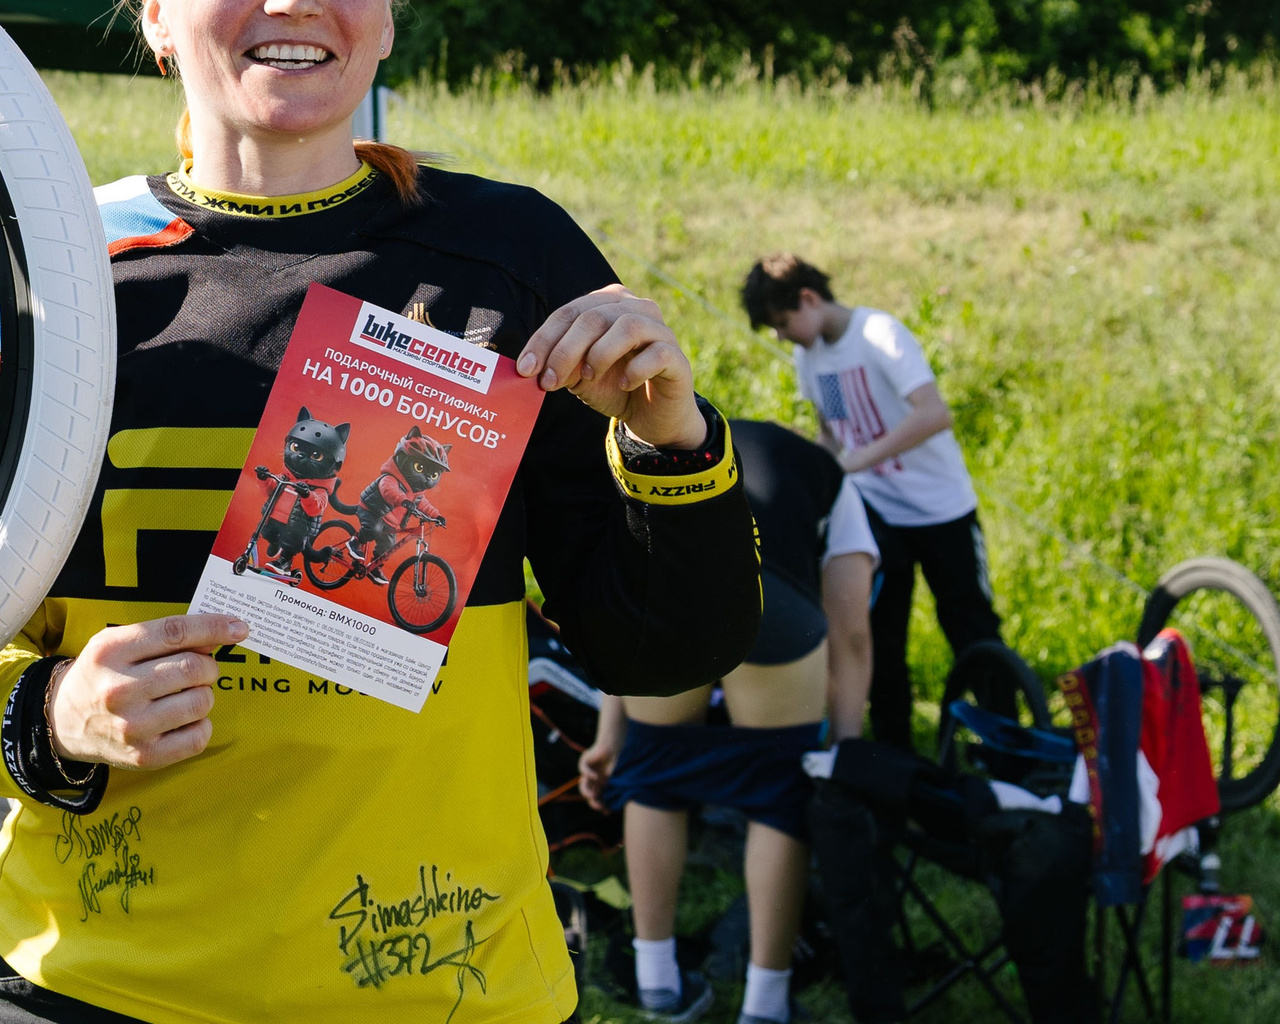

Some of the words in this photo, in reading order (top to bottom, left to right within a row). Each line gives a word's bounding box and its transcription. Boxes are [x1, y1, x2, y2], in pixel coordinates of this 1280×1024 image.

[202, 195, 274, 216] ЖМИ
[280, 203, 303, 215] И
[302, 358, 332, 385] НА
[339, 373, 394, 407] 1000
[324, 347, 413, 390] ПОДАРОЧНЫЙ
[414, 383, 498, 422] СЕРТИФИКАТ
[392, 347, 422, 362] МАГАЗИНЫ
[421, 357, 458, 376] СПОРТИВНЫХ
[457, 371, 481, 384] ТОВАРОВ
[649, 479, 716, 497] FRIZZY
[274, 589, 327, 617] Промокод:
[328, 610, 376, 635] BMX1000
[2, 674, 26, 729] TEAM
[210, 676, 291, 694] CING
[2, 738, 37, 795] FRIZZY
